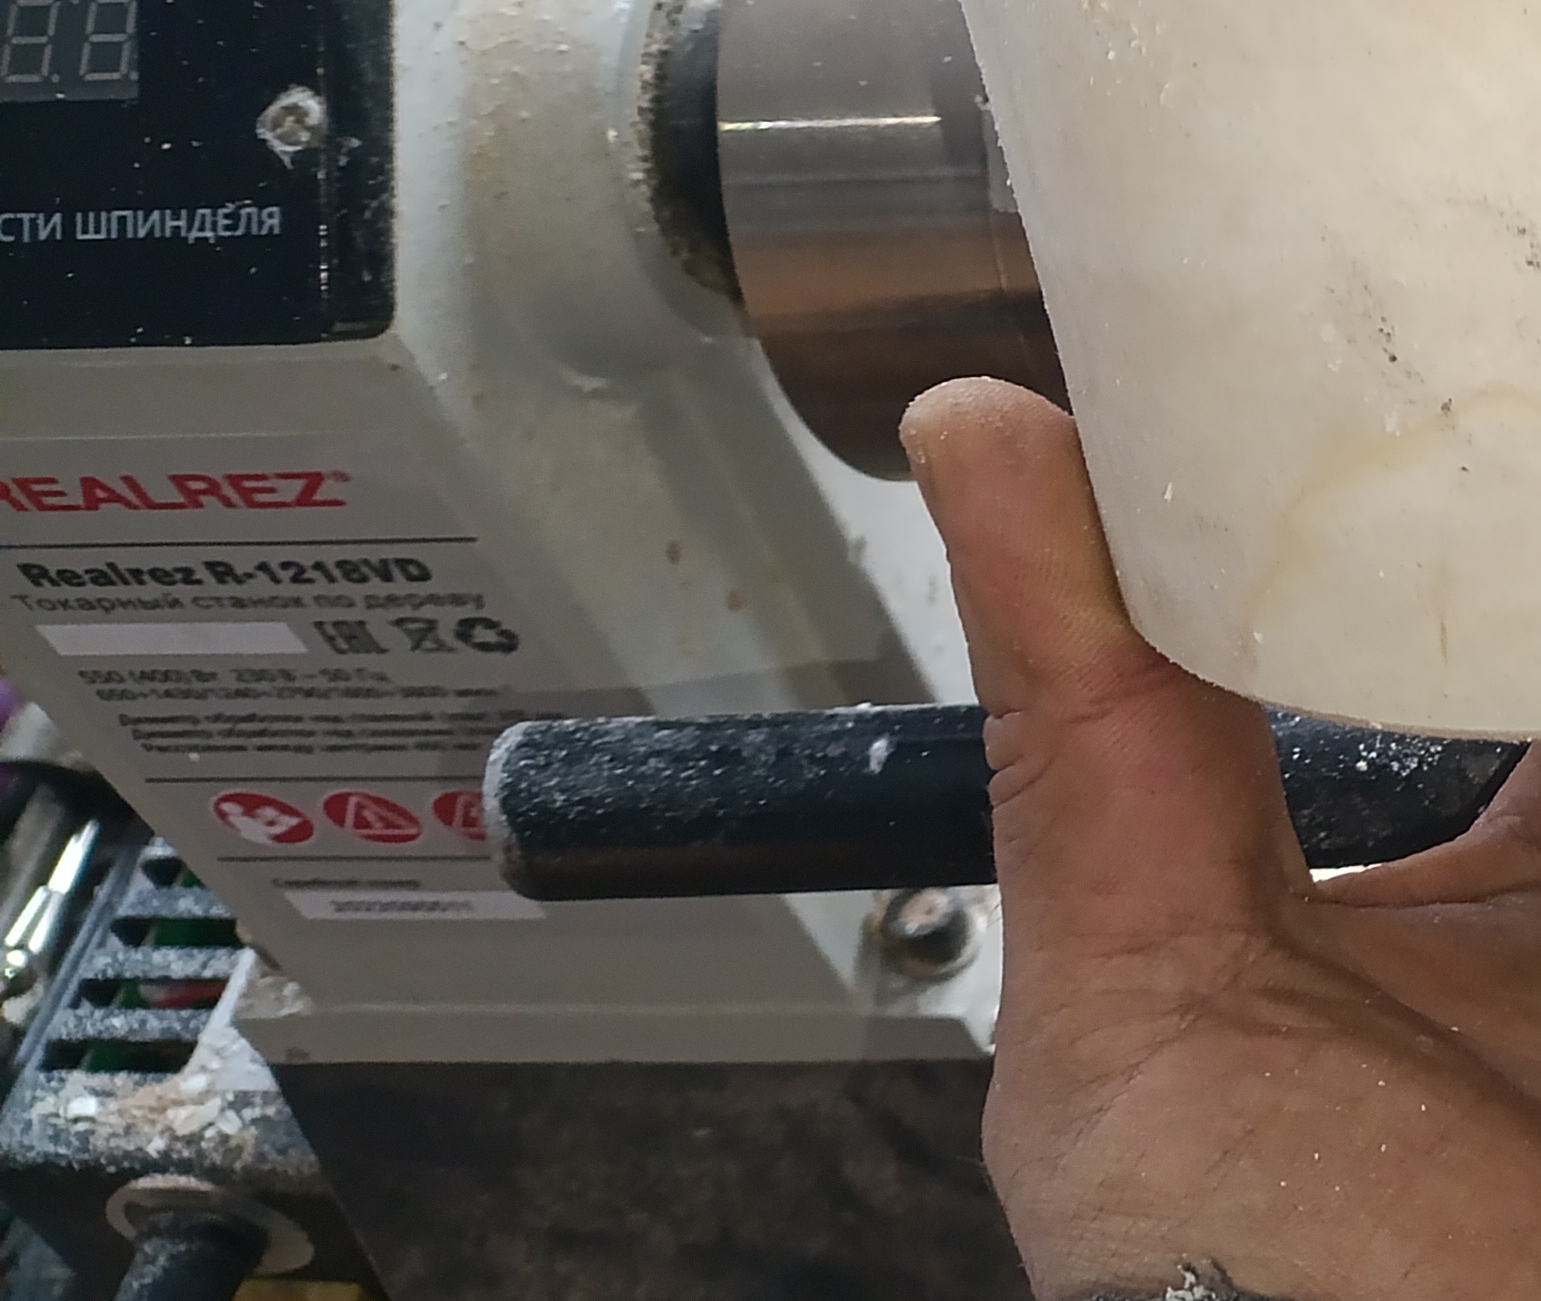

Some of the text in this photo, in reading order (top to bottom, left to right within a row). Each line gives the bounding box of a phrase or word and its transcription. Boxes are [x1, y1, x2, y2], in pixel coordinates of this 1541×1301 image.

[75, 206, 282, 244] ШПИНДЕЛЯ
[16, 558, 433, 588] Realrez R-1218VD
[10, 593, 184, 613] Токарный
